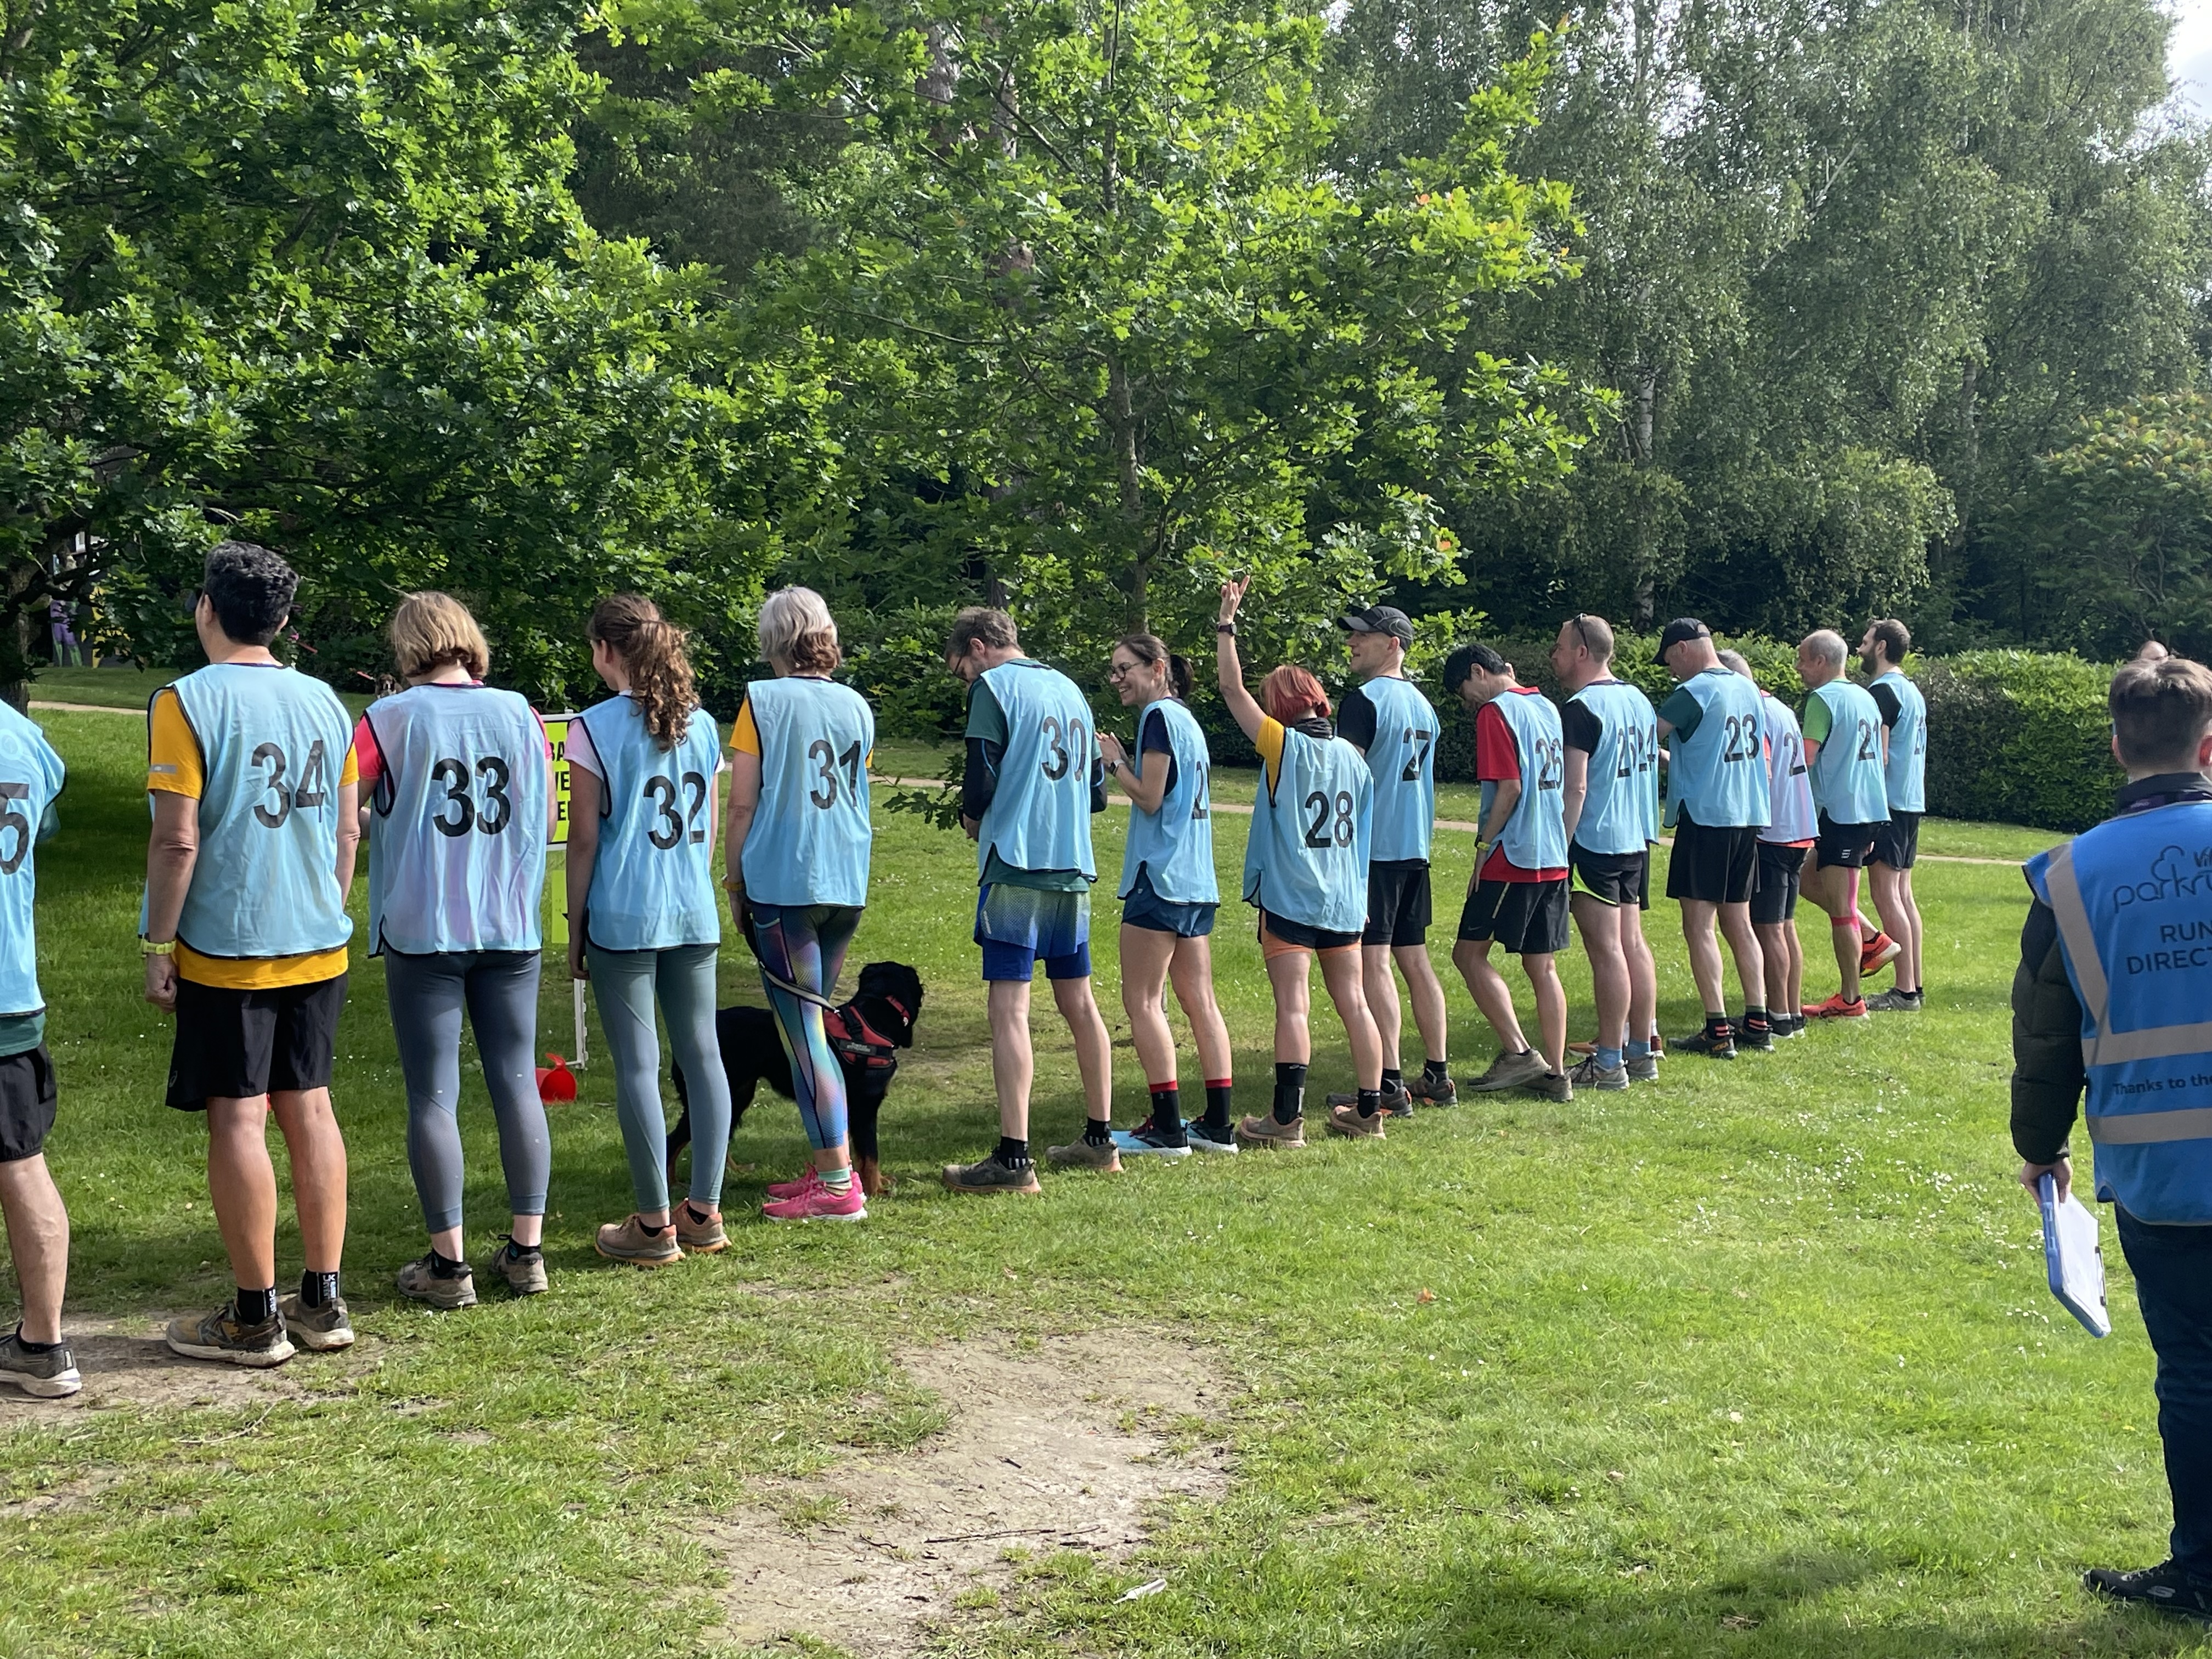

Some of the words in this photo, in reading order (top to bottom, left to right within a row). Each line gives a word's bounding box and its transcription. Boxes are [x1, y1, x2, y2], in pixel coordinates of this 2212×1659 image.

[1041, 716, 1086, 782] 30
[1402, 727, 1432, 781] 27
[1536, 737, 1562, 791] 26
[1724, 714, 1759, 763] 23
[1784, 731, 1805, 777] 2
[251, 739, 325, 828] 34
[432, 757, 511, 837] 33
[808, 739, 861, 810] 31
[1192, 761, 1210, 819] 2
[644, 771, 706, 850] 32
[1305, 791, 1353, 848] 28
[2113, 1079, 2163, 1094] Thanks
[2168, 1078, 2186, 1089] to
[2191, 1074, 2212, 1087] th
